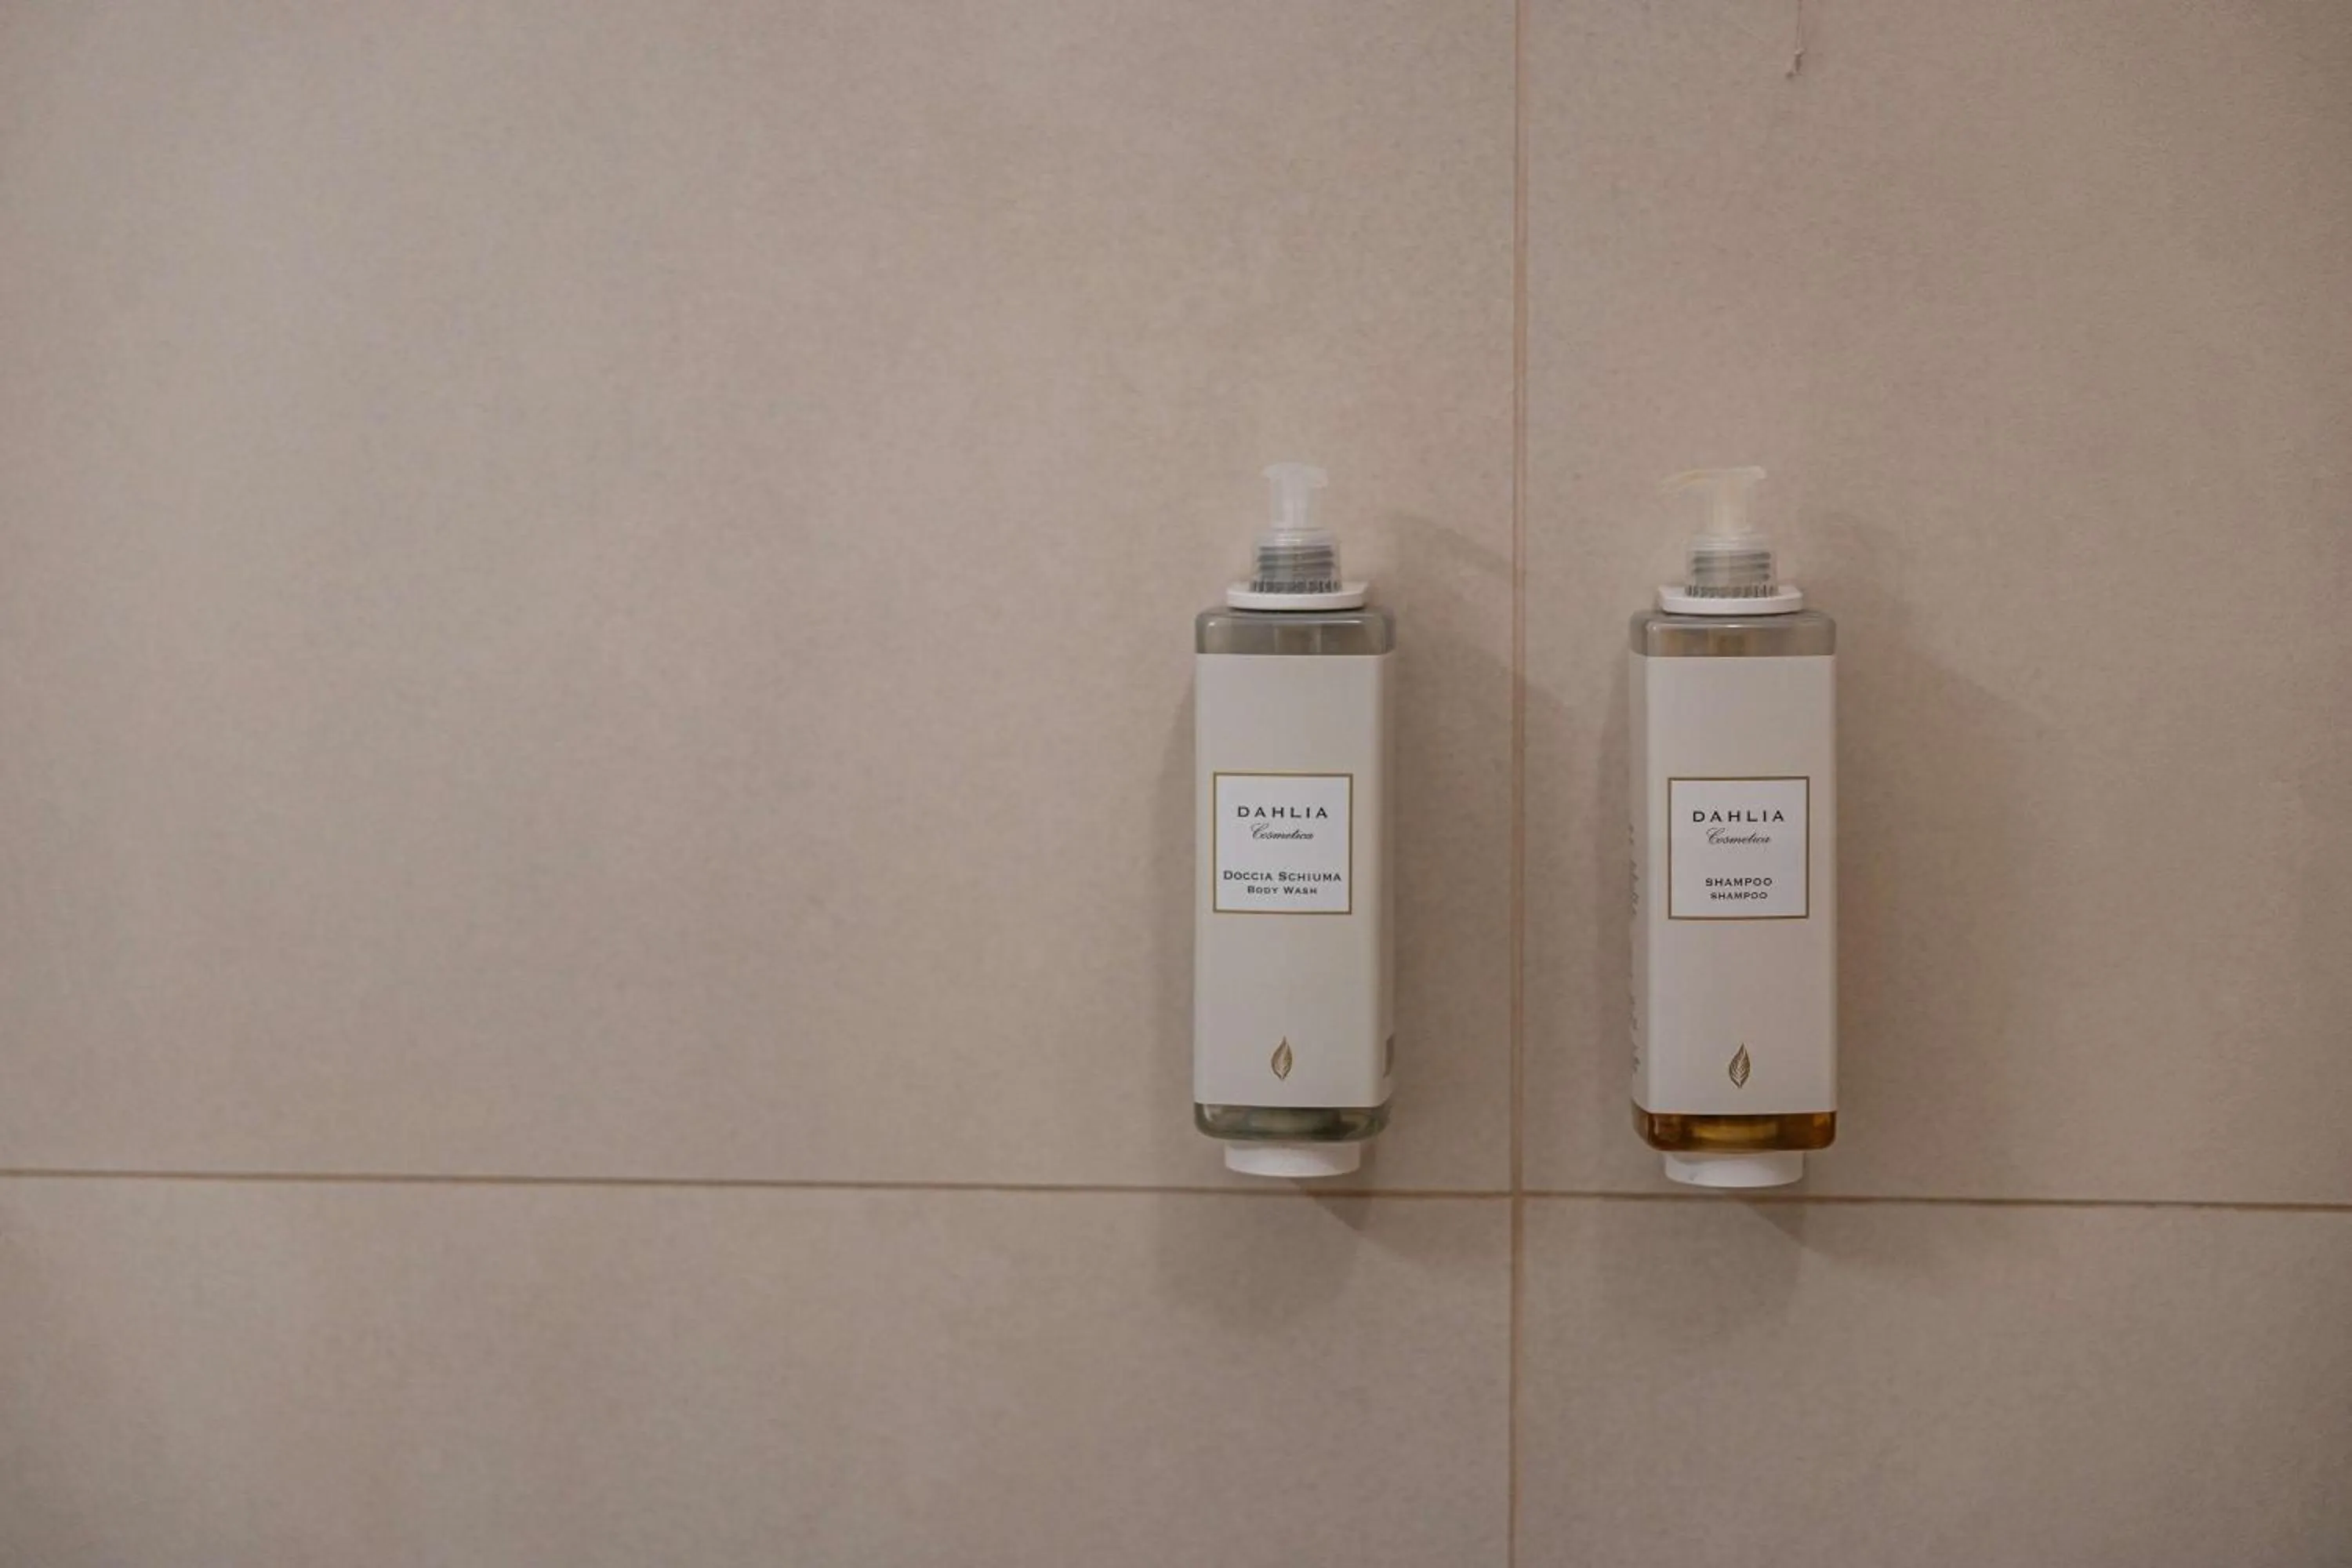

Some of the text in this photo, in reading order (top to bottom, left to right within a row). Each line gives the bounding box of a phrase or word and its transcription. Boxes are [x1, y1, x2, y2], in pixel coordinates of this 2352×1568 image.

[1237, 806, 1328, 819] DAHLIA
[1693, 810, 1784, 823] DAHLIA
[1250, 822, 1314, 840] Cosmetica
[1706, 827, 1771, 844] Cosmetica
[1223, 869, 1342, 883] DOCCIA SCHIUMA
[1705, 877, 1773, 887] SHAMPOO
[1710, 891, 1768, 900] SHAMPOO
